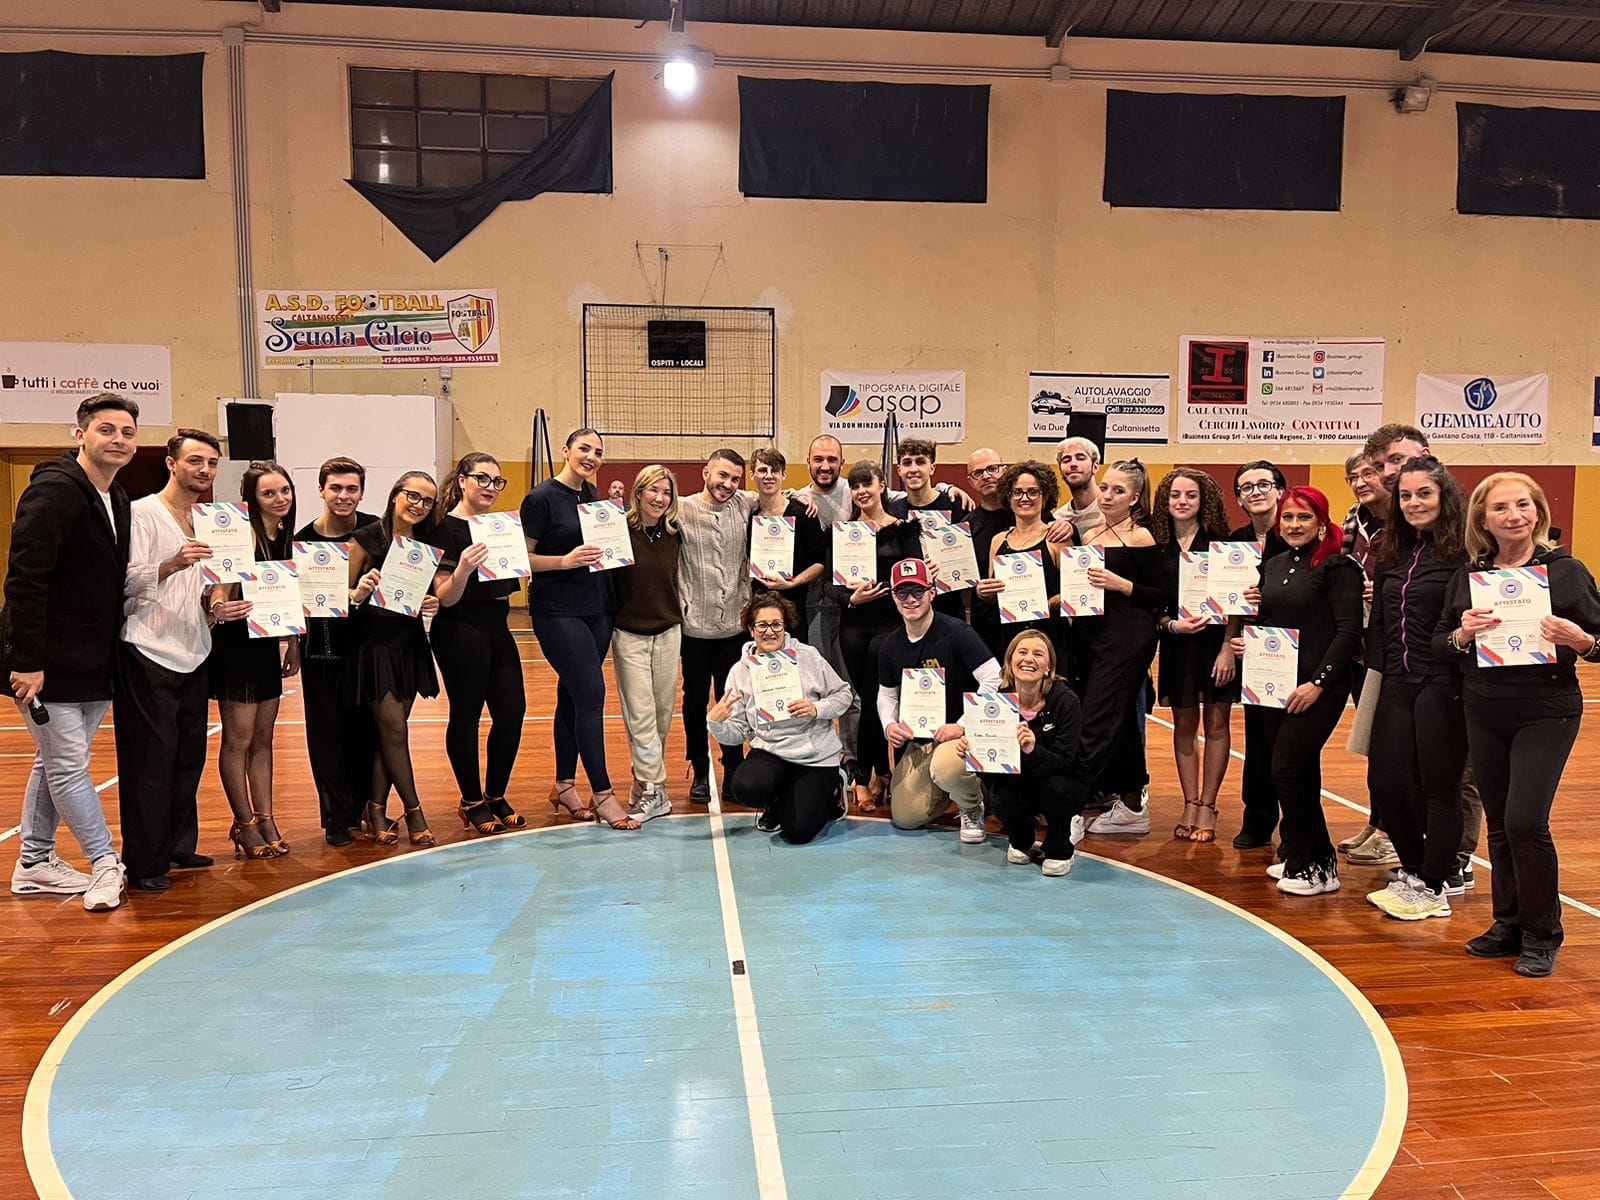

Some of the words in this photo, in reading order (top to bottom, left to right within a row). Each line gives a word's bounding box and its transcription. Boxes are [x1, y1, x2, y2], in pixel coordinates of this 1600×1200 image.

[264, 293, 330, 312] A.S.D.
[265, 317, 357, 353] Scuola
[364, 318, 433, 352] Calcio
[651, 359, 674, 367] OSPITI
[680, 359, 704, 367] LOCALI
[22, 376, 49, 389] tutti
[52, 377, 56, 389] i
[60, 377, 99, 390] caffè
[103, 378, 127, 390] che
[131, 379, 160, 391] vuoi
[858, 383, 917, 393] TIPOGRAFIA
[918, 383, 961, 393] DIGITALE
[1074, 386, 1152, 397] AUTOLAVAGGIO
[1085, 396, 1105, 405] F.LLI
[1106, 396, 1147, 405] SCRIBANI
[866, 394, 942, 420] asap
[1186, 405, 1211, 416] CALL
[1212, 405, 1248, 416] CENTER
[828, 421, 841, 430] VIA
[842, 421, 856, 430] DON
[909, 421, 962, 429] CALTANISSETTA
[1199, 419, 1239, 431] CERCHI
[1240, 419, 1286, 431] LAVORO?
[1291, 418, 1360, 431] CONTATTACI
[1420, 412, 1542, 429] GIEMMEAUTO
[1033, 422, 1047, 431] Via
[1048, 422, 1065, 432] Due
[1112, 423, 1161, 433] Caltanissetta
[1211, 433, 1230, 442] Group
[1231, 433, 1241, 441] Srl
[1246, 433, 1262, 441] Viale
[1262, 433, 1278, 441] della
[1279, 433, 1305, 442] Regione,
[1431, 432, 1460, 440] Gaetano
[1461, 432, 1482, 441] Costa,
[1499, 431, 1543, 440] Caltanissetta
[1493, 598, 1532, 607] ATTESTATO
[1258, 652, 1286, 660] ATTESTATO
